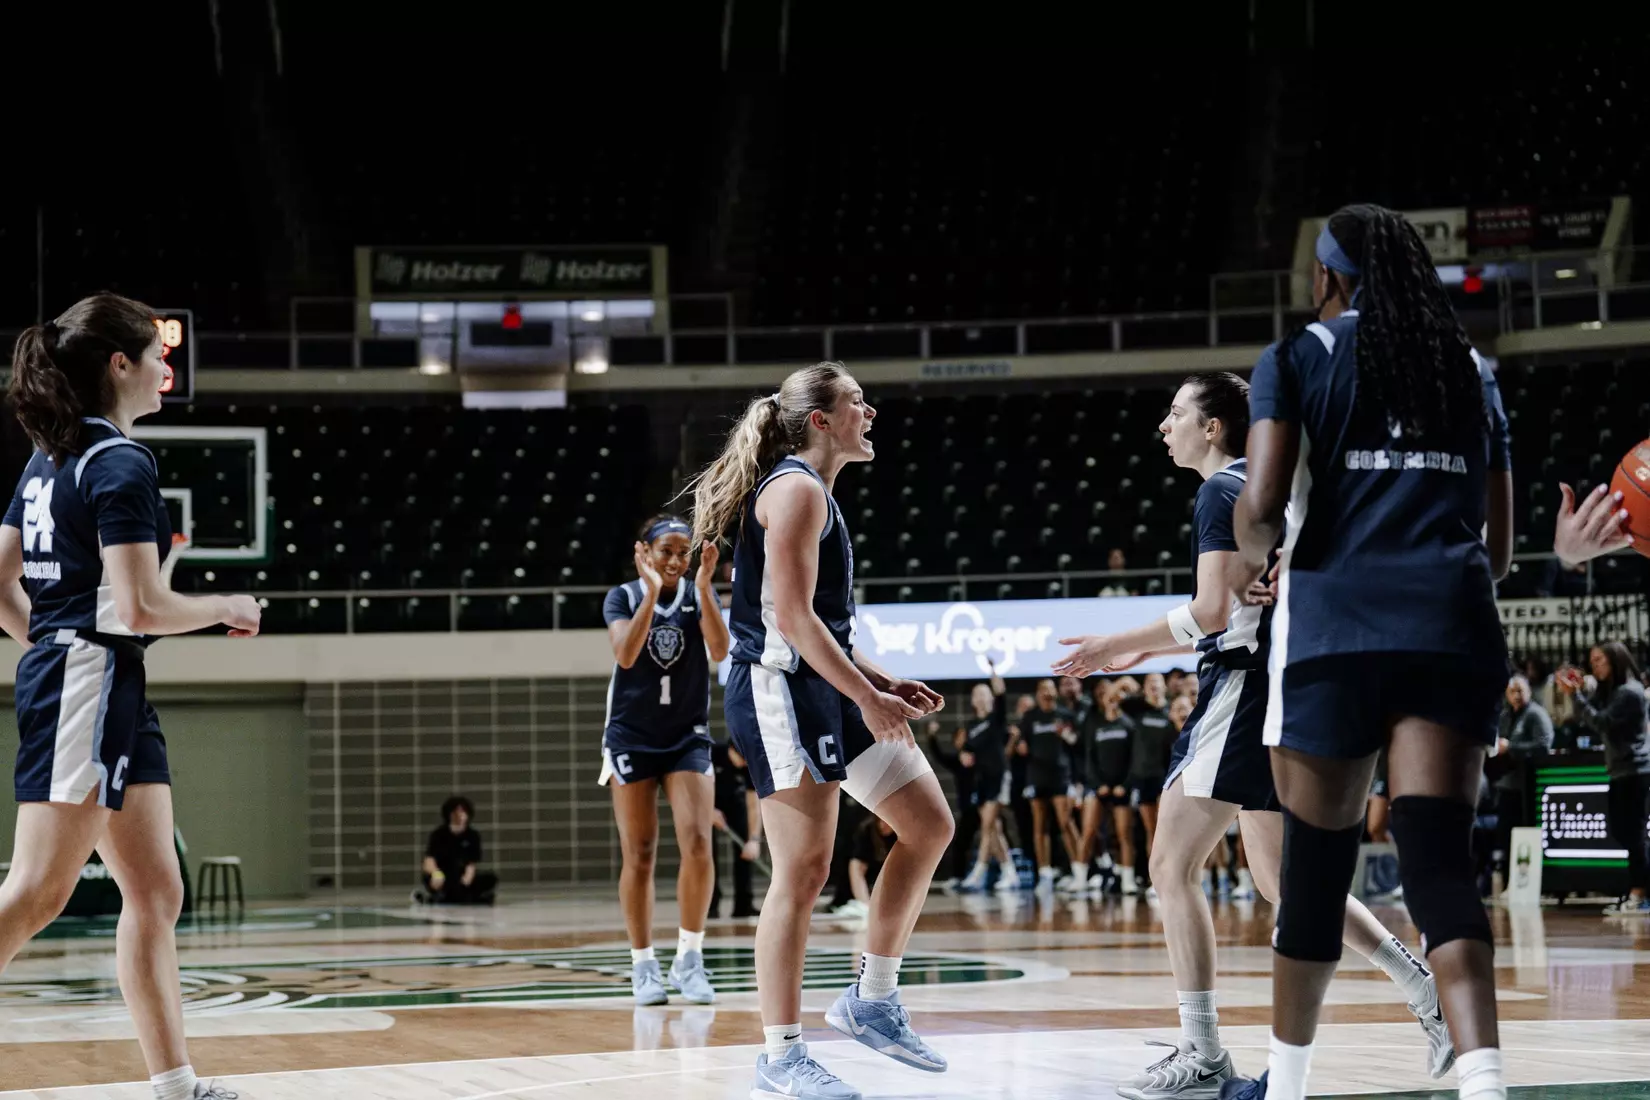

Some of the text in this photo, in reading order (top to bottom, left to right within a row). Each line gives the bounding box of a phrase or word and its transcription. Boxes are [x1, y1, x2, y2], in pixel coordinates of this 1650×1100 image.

[411, 260, 647, 281] Holzer Holzer
[1502, 605, 1547, 619] TED
[923, 603, 1053, 676] Kroger
[659, 675, 671, 705] 1
[617, 754, 633, 775] C
[818, 735, 837, 765] C
[112, 756, 128, 790] C
